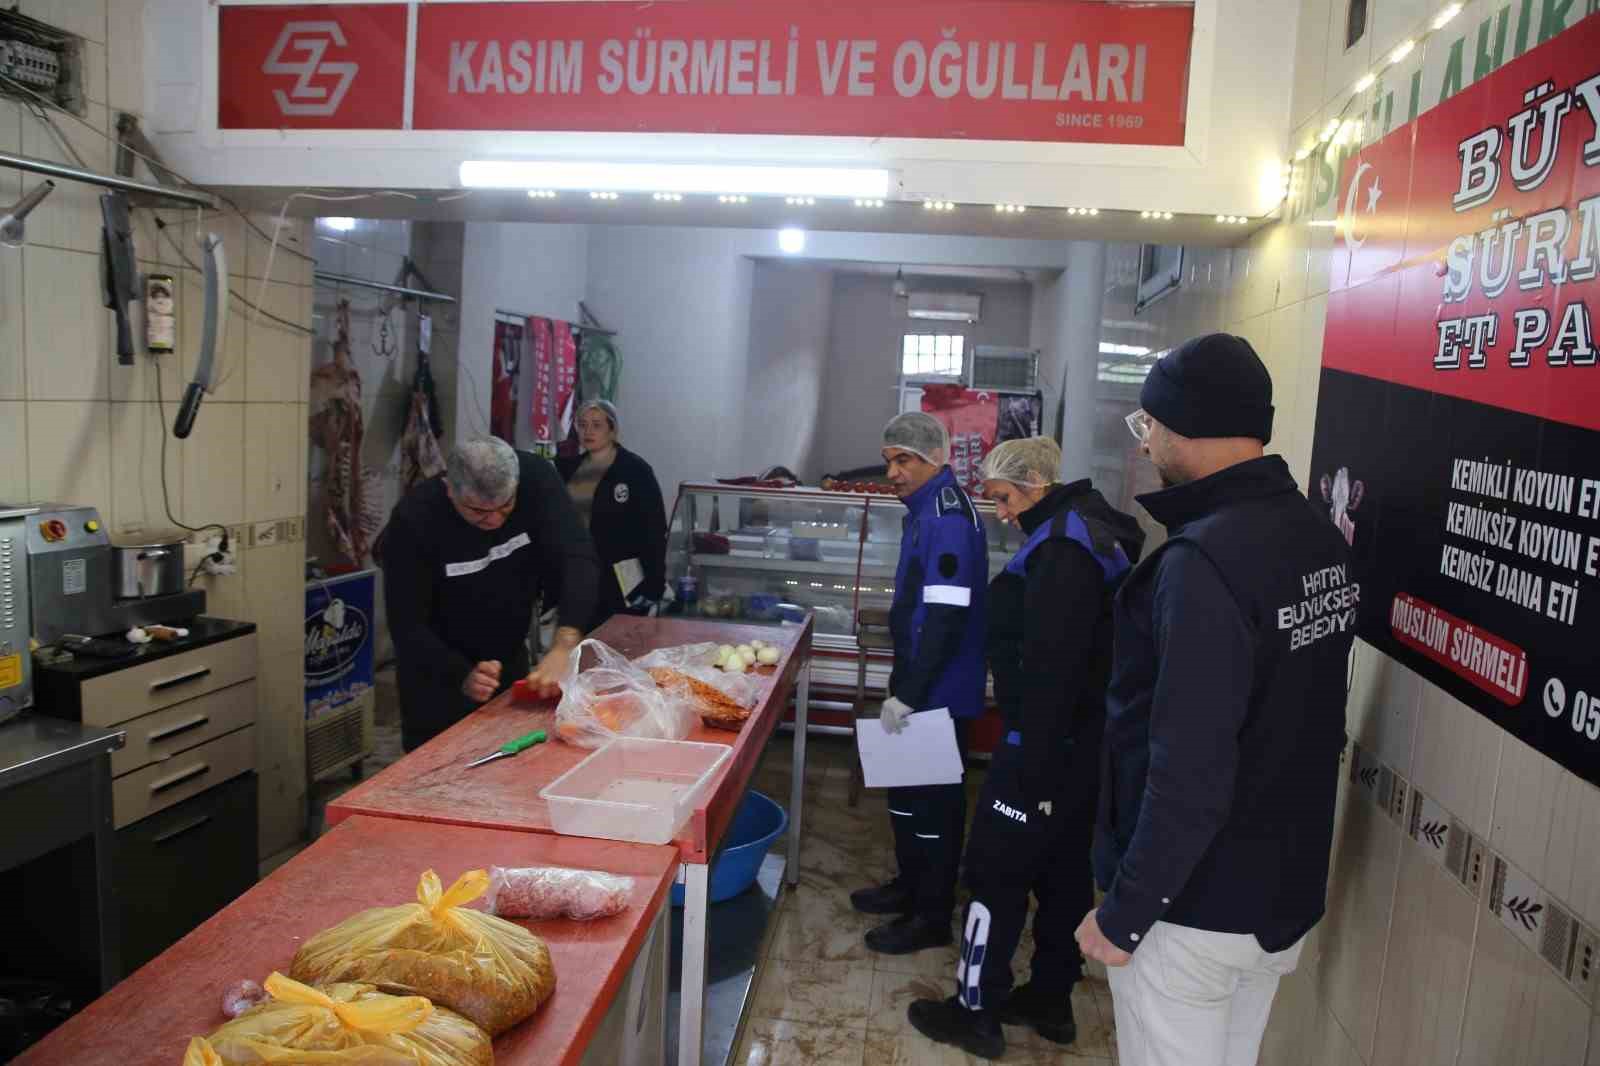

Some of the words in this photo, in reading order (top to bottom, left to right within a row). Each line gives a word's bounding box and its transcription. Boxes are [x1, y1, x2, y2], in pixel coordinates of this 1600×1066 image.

[447, 40, 584, 95] KASIM
[597, 25, 799, 97] SÜRMELİ
[816, 39, 878, 97] VE
[893, 26, 1148, 103] OĞULLARI
[1055, 112, 1103, 128] SINCE
[1107, 114, 1144, 129] 1969
[1434, 312, 1498, 369] ET
[1509, 300, 1600, 367] PA
[1451, 456, 1512, 500] KEMİKLİ
[1512, 468, 1575, 514] KOYUN
[1446, 502, 1517, 550] KEMİKSİZ
[1518, 520, 1582, 571] KOYUN
[1302, 562, 1346, 597] HATAY
[1440, 544, 1495, 593] KEMSİZ
[1495, 563, 1543, 613] DANA
[1546, 580, 1579, 626] ETİ
[1391, 596, 1450, 656] MÜSLÜM
[1450, 624, 1527, 698] SÜRMELİ
[992, 799, 1027, 824] ZABITA
